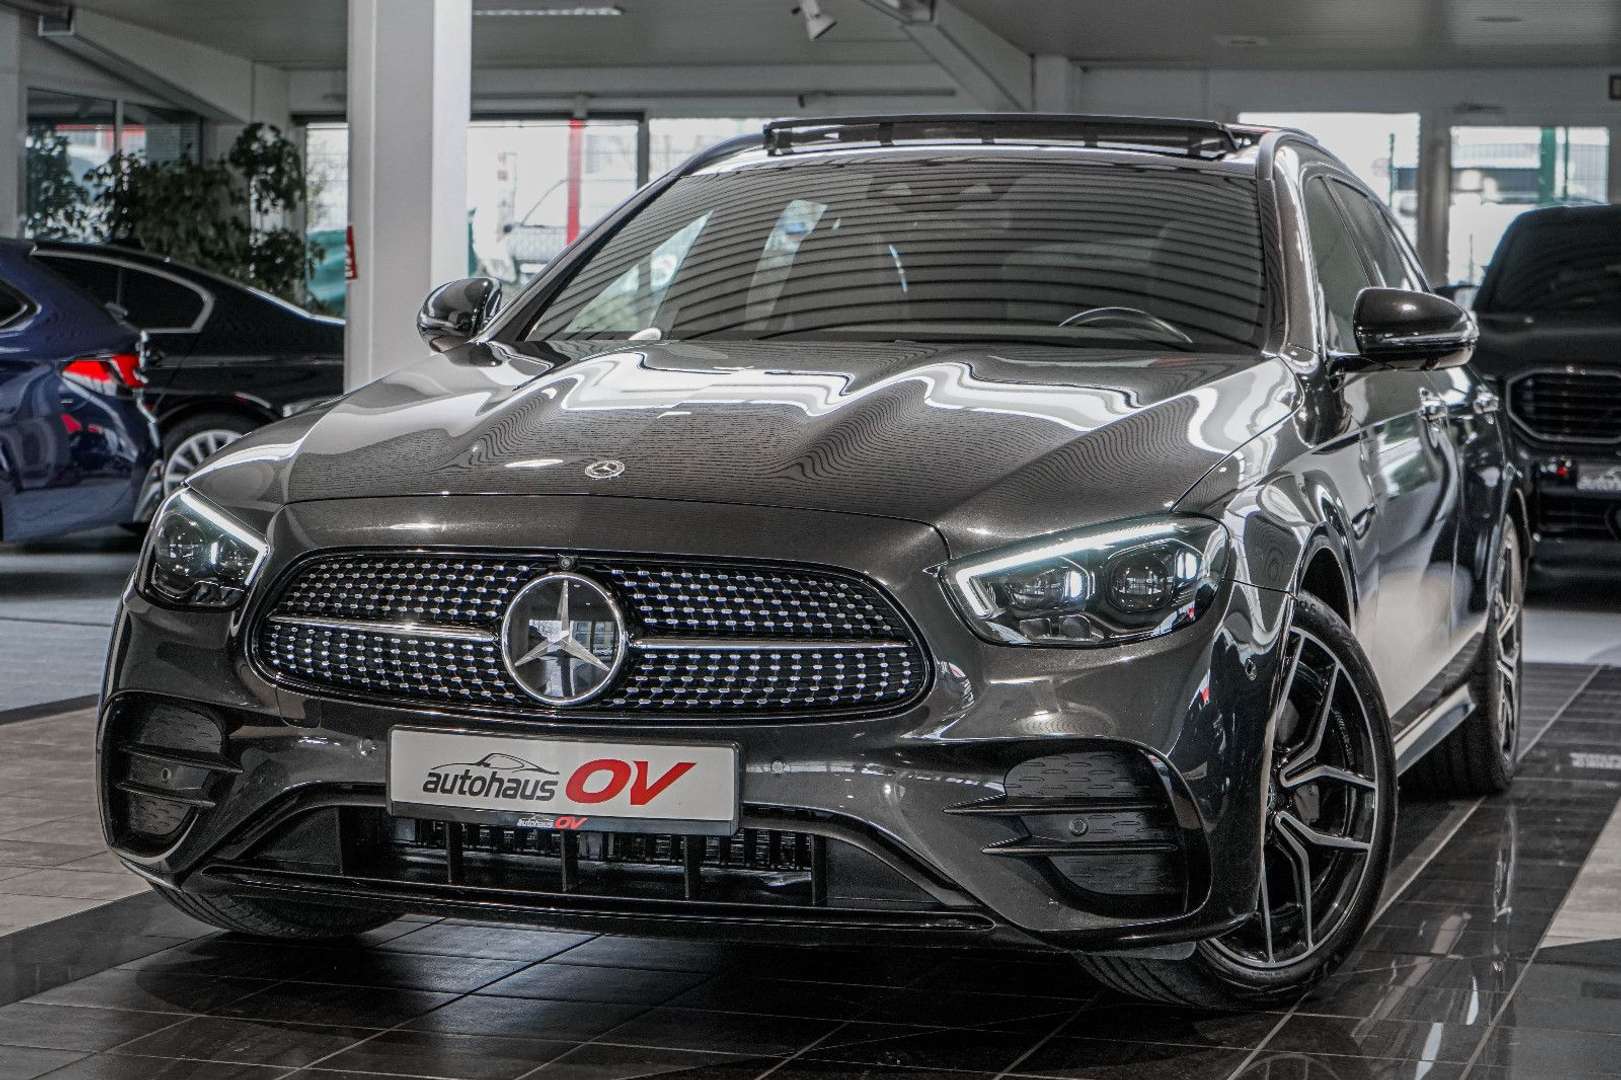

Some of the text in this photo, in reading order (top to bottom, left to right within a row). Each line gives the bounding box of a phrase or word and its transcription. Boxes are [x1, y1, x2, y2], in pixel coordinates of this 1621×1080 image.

[422, 759, 697, 805] autohaus OV
[516, 815, 588, 831] autohaus OV
